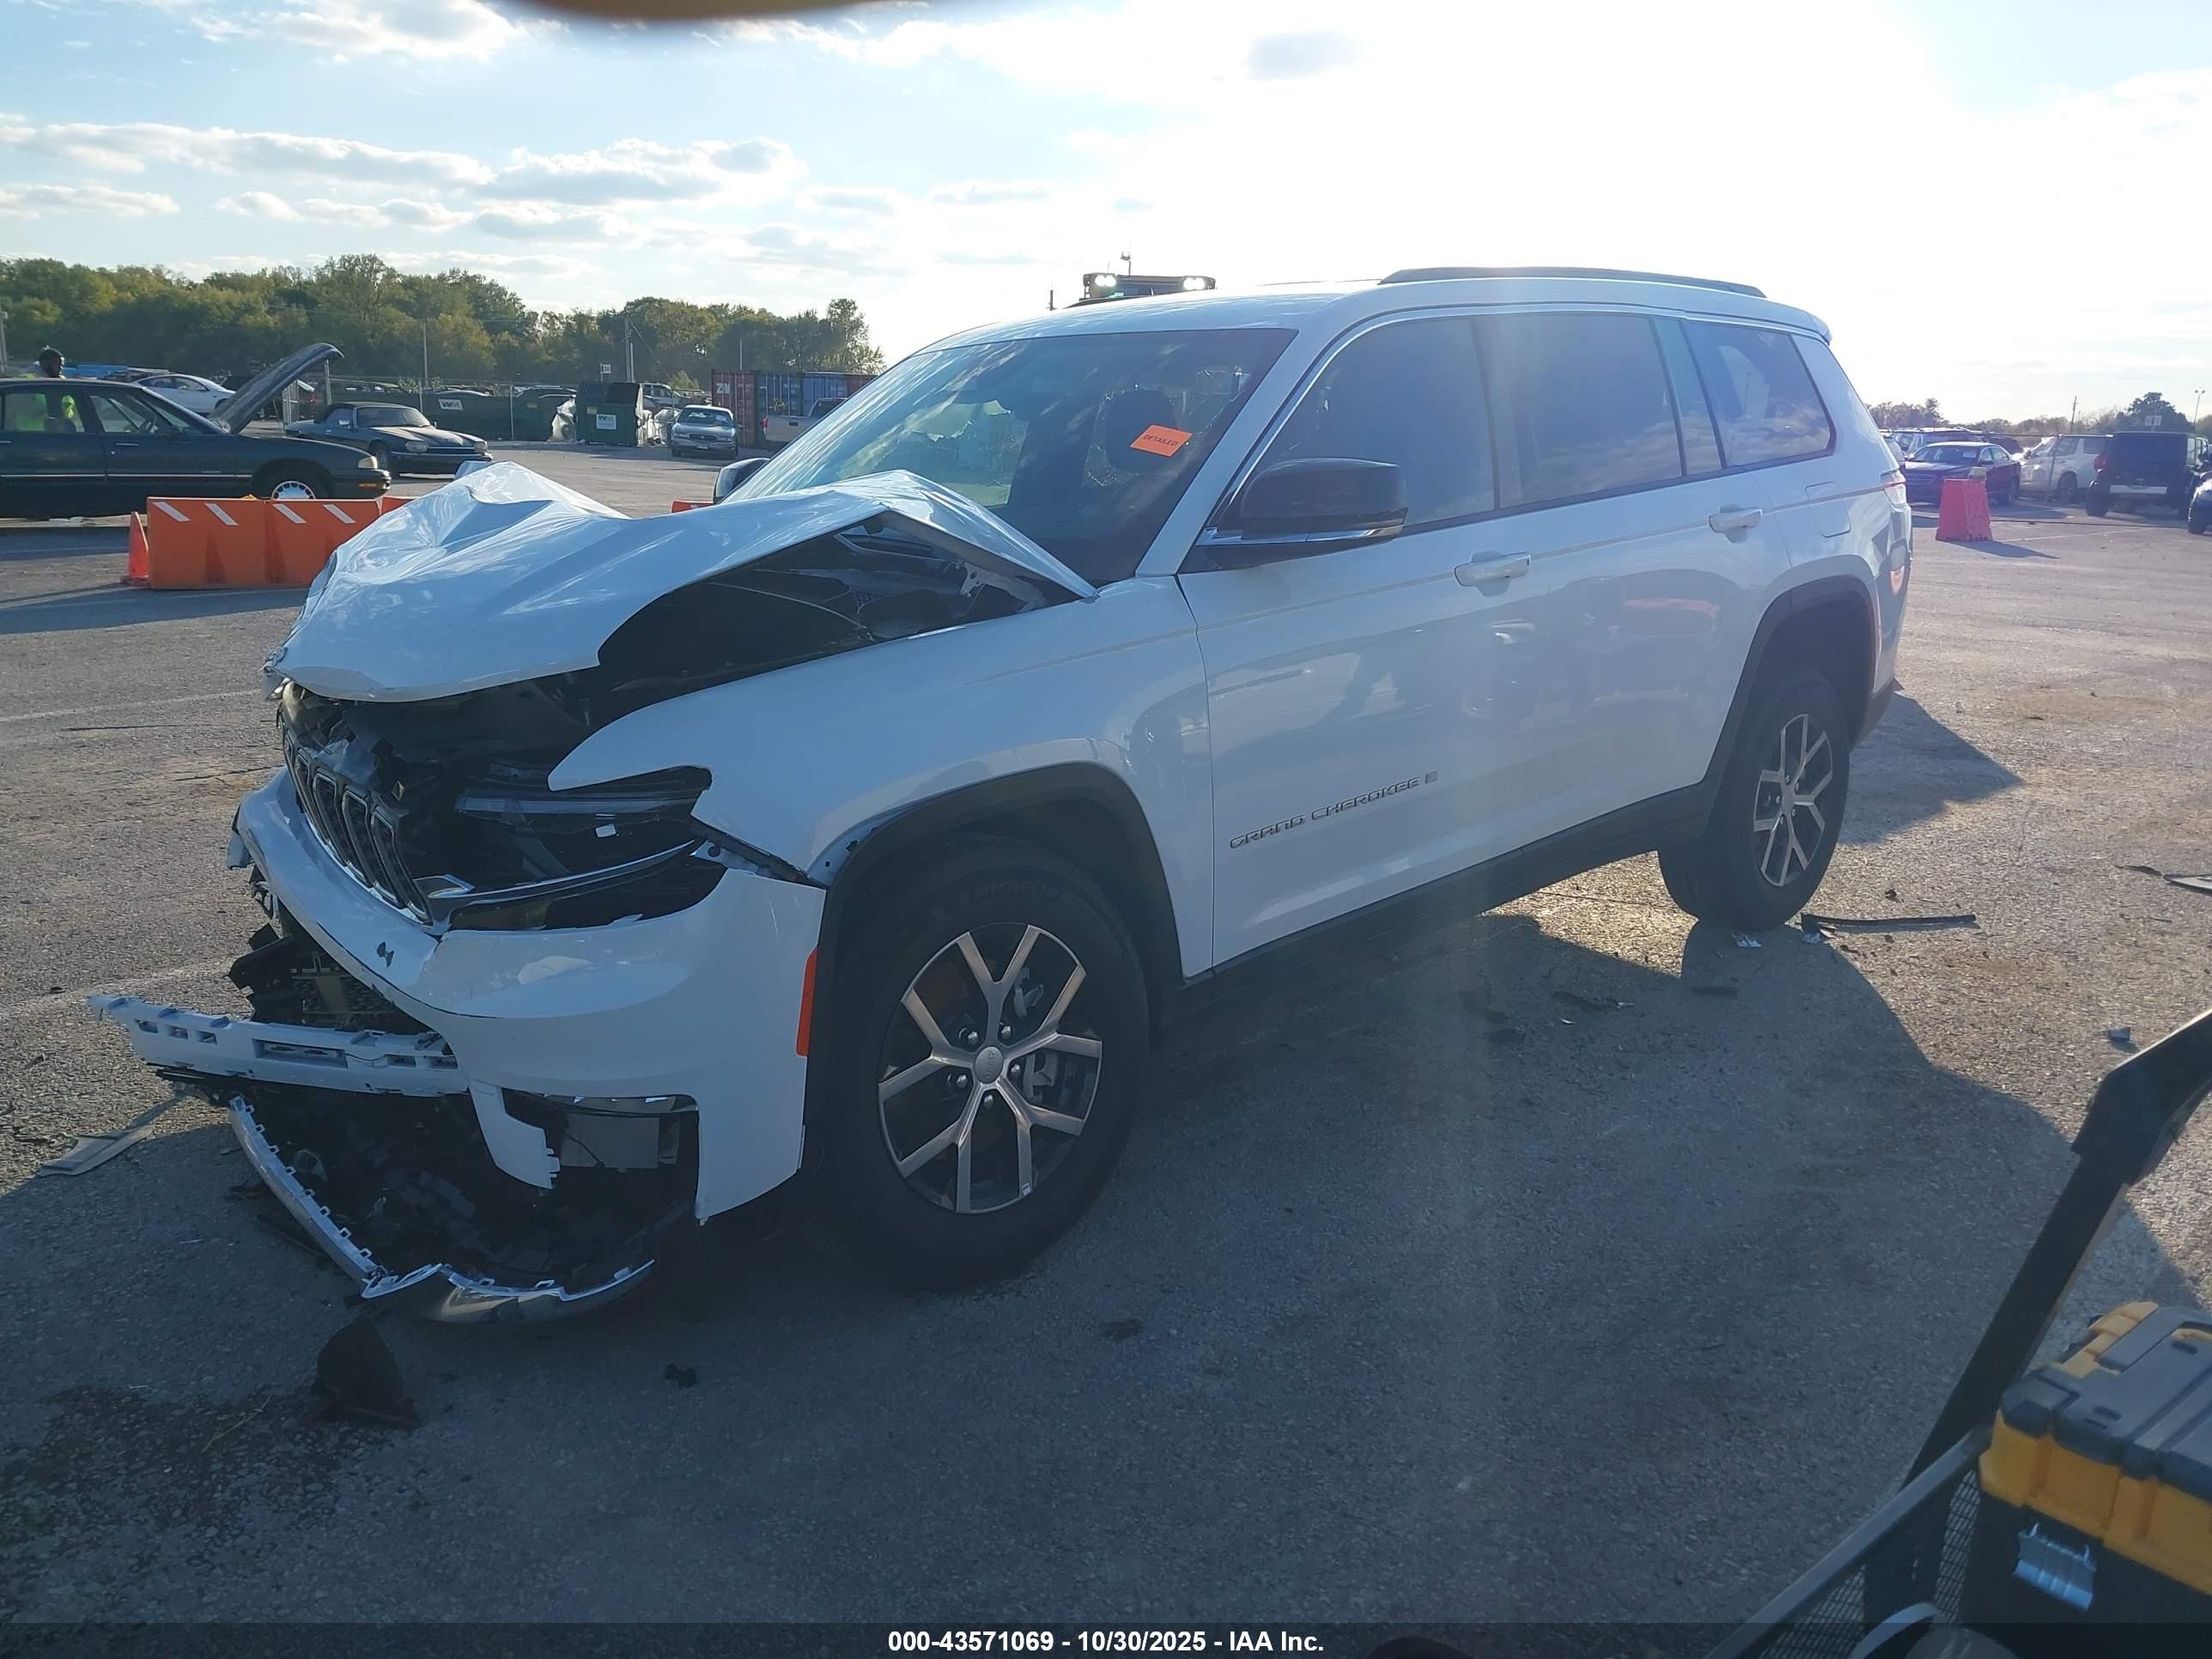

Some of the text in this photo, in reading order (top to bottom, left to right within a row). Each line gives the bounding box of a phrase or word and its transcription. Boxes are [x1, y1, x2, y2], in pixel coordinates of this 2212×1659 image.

[1143, 434, 1178, 447] DETAILED
[1230, 776, 1419, 849] GRAND CHEROKEE
